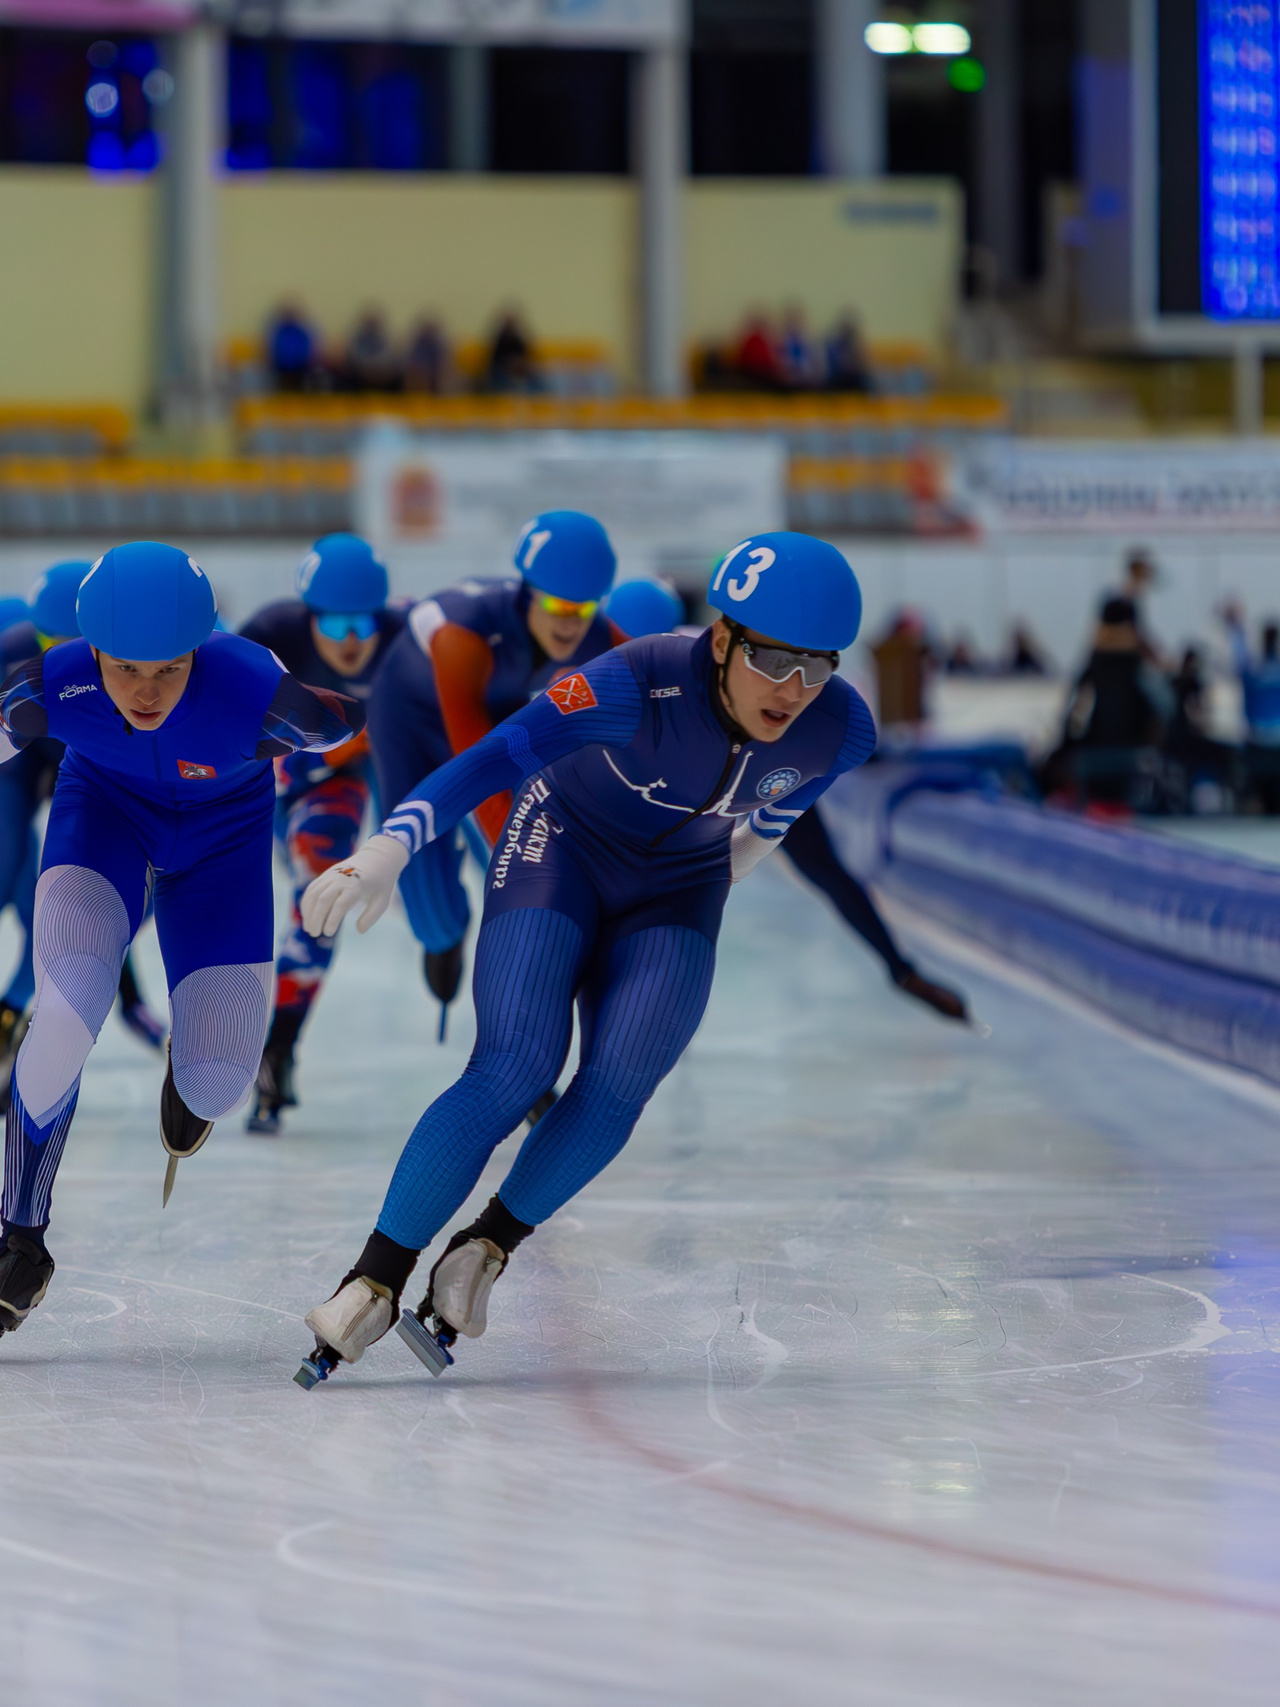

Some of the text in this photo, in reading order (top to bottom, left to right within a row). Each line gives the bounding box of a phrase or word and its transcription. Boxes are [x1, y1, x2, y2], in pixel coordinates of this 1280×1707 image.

[712, 541, 776, 602] 13
[59, 684, 98, 701] FORMA
[492, 778, 551, 889] Петербург
